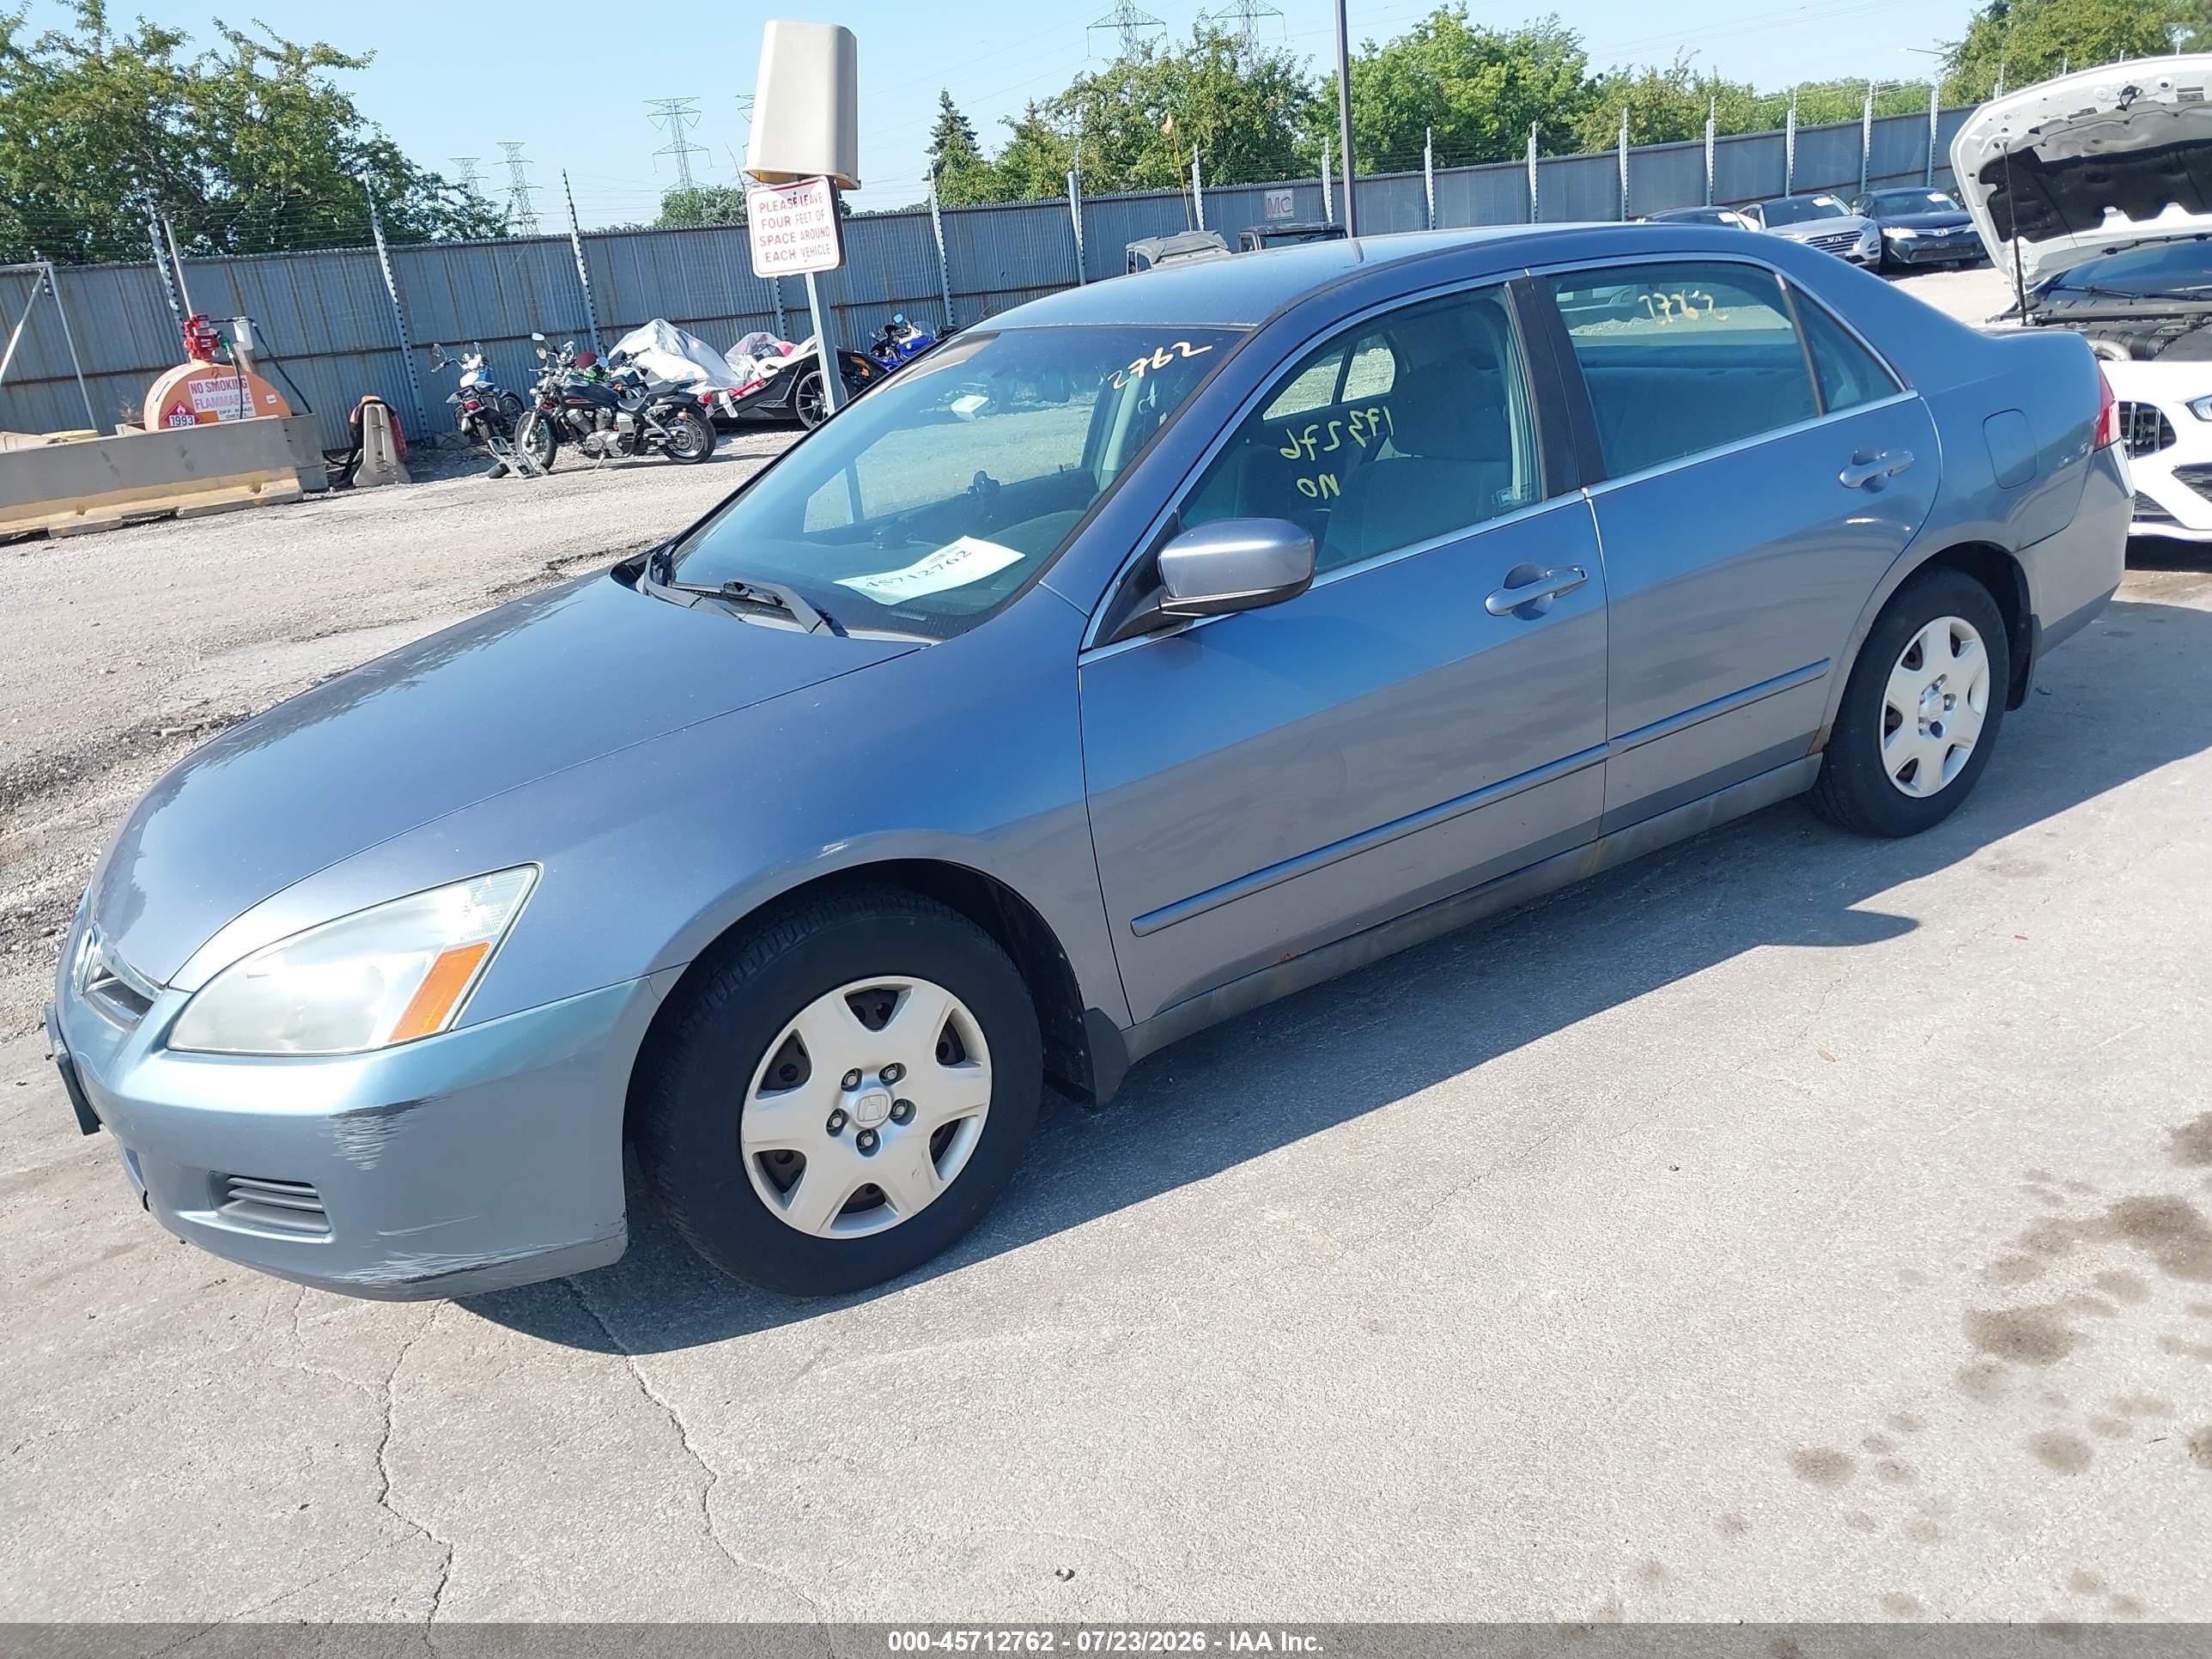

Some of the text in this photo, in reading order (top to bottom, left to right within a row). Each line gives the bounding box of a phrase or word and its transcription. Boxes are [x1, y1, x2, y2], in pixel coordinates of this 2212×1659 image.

[759, 191, 823, 213] PLEASE LEAVE
[1267, 197, 1293, 214] MC
[761, 209, 825, 230] FOUR FEET OF
[759, 226, 830, 247] SPACE AROUND
[765, 243, 830, 263] EACH VEHICLE
[1108, 342, 1213, 389] 2762
[191, 382, 204, 394] NO
[171, 416, 194, 426] 1993
